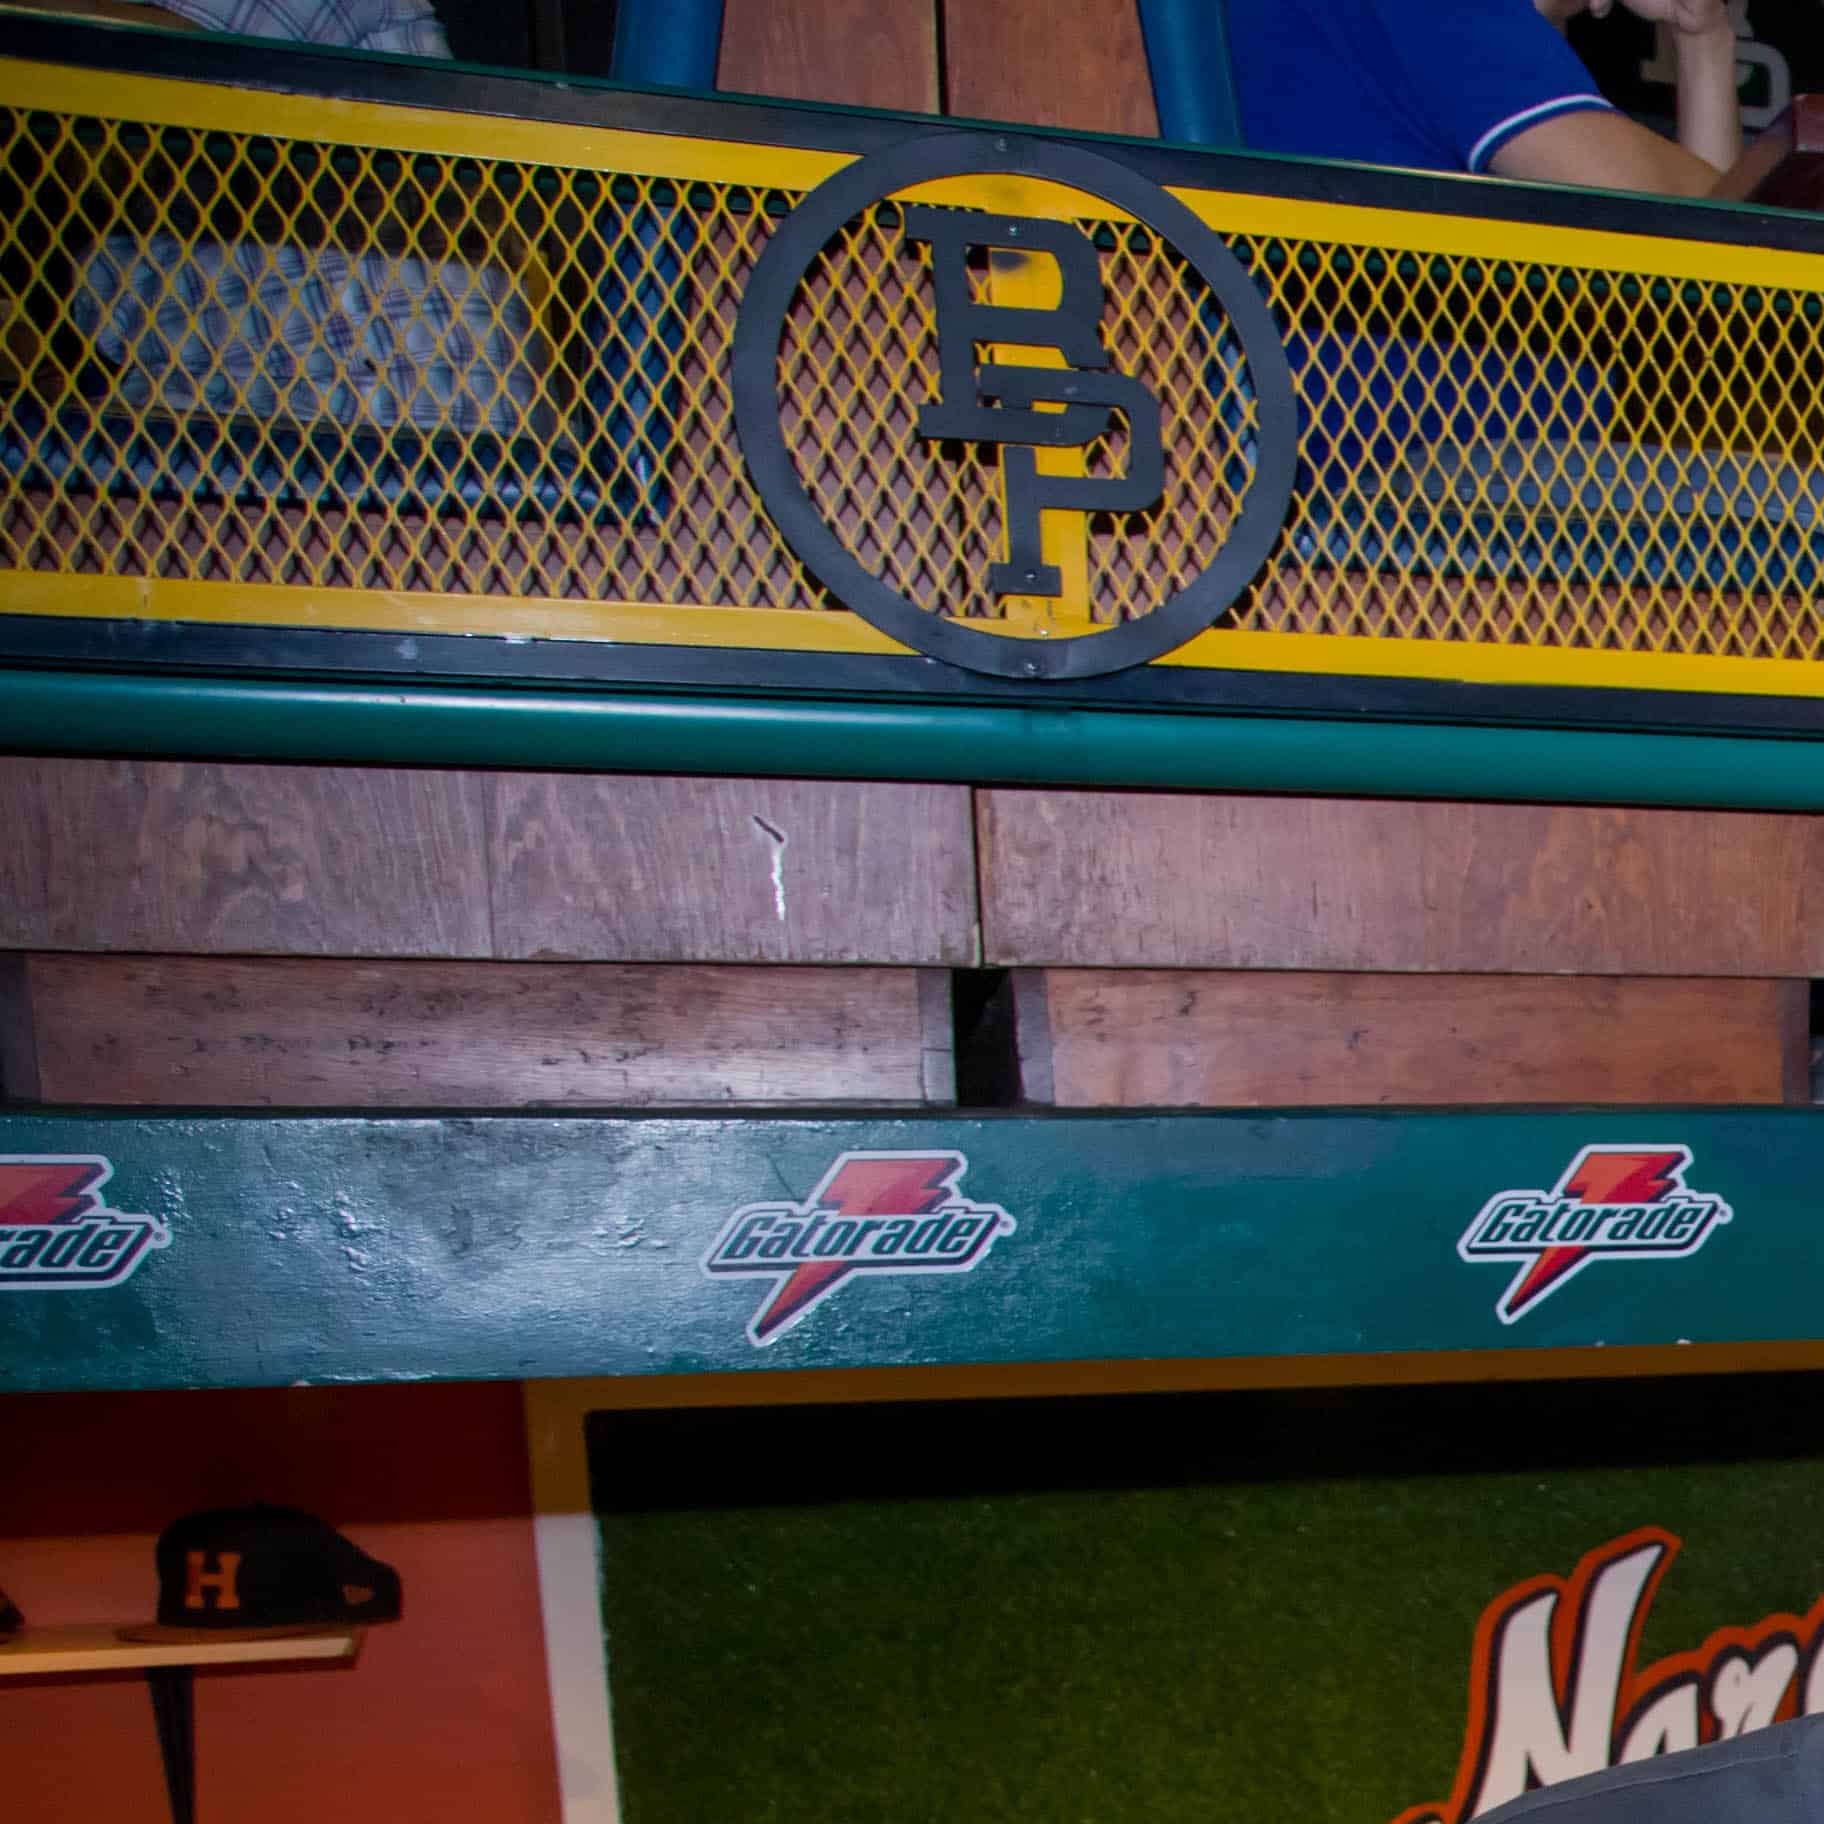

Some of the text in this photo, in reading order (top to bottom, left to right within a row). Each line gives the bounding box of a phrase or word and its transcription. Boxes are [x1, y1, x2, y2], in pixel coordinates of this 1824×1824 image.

[719, 1211, 986, 1260] Gatorade
[1476, 1201, 1705, 1243] Gatorade
[185, 1551, 242, 1611] H
